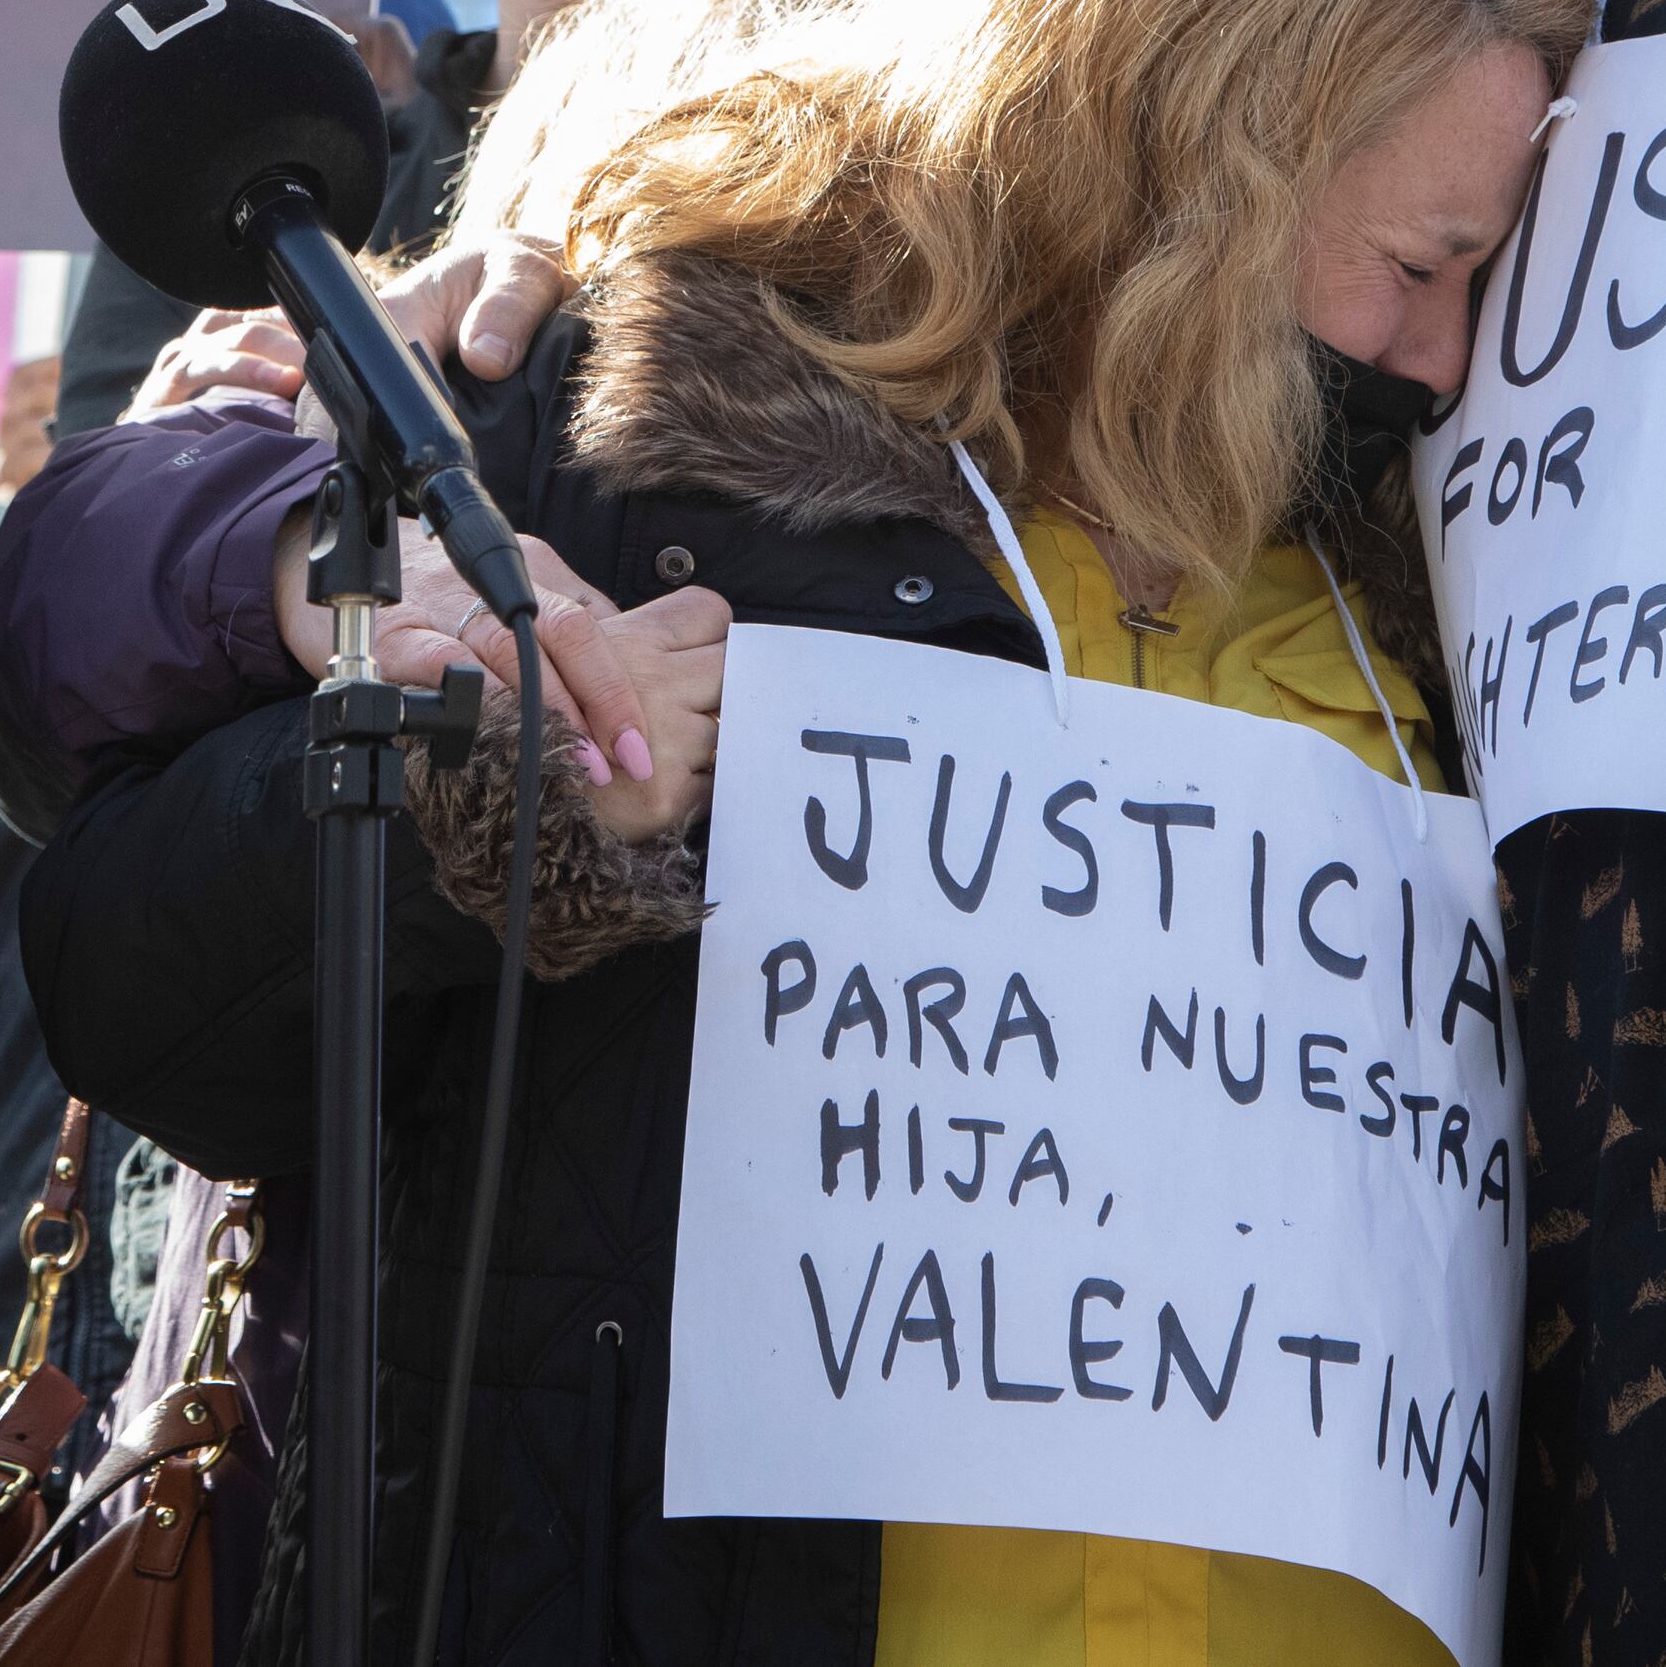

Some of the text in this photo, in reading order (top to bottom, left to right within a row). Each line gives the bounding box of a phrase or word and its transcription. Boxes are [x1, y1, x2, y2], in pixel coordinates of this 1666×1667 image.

[1439, 404, 1596, 562] FOR
[800, 727, 1507, 1088] JUSTICIA
[759, 937, 1513, 1248] PARA NUESTRA
[818, 1087, 1115, 1230] HIJA,
[799, 1240, 1496, 1579] VALENTINA
